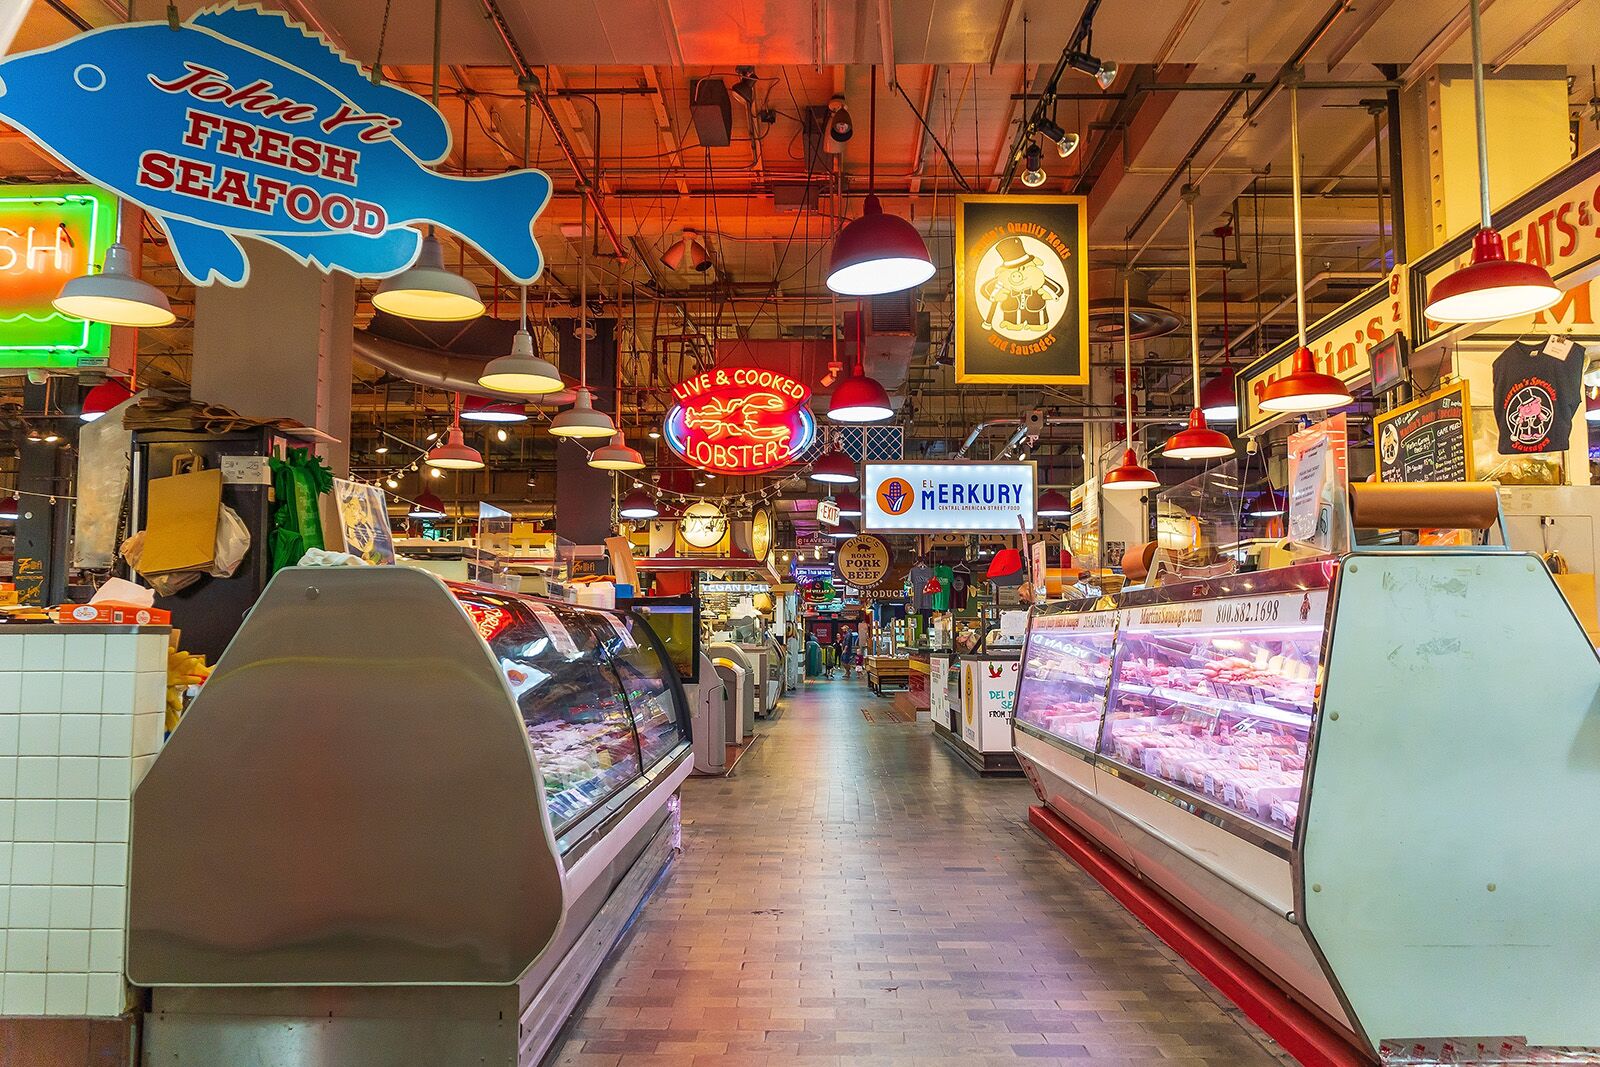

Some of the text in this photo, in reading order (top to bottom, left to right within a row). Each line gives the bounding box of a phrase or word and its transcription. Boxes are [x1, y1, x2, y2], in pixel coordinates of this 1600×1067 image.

[148, 62, 401, 142] John Yi
[183, 107, 360, 186] FRESH
[137, 150, 388, 238] SEAFOOD
[1007, 222, 1047, 239] Quality
[1046, 231, 1072, 260] Meats
[988, 333, 1057, 356] and Sausages
[674, 369, 804, 399] LIVE & COOKED
[687, 436, 791, 468] LOBSTERS
[1512, 438, 1550, 452] Sausages
[923, 480, 933, 488] EL
[922, 484, 1023, 510] MERKURY
[823, 506, 838, 522] EXIT
[860, 590, 904, 598] PRODUCE
[1215, 600, 1280, 623] 800.882.1698
[989, 691, 1005, 699] DEL
